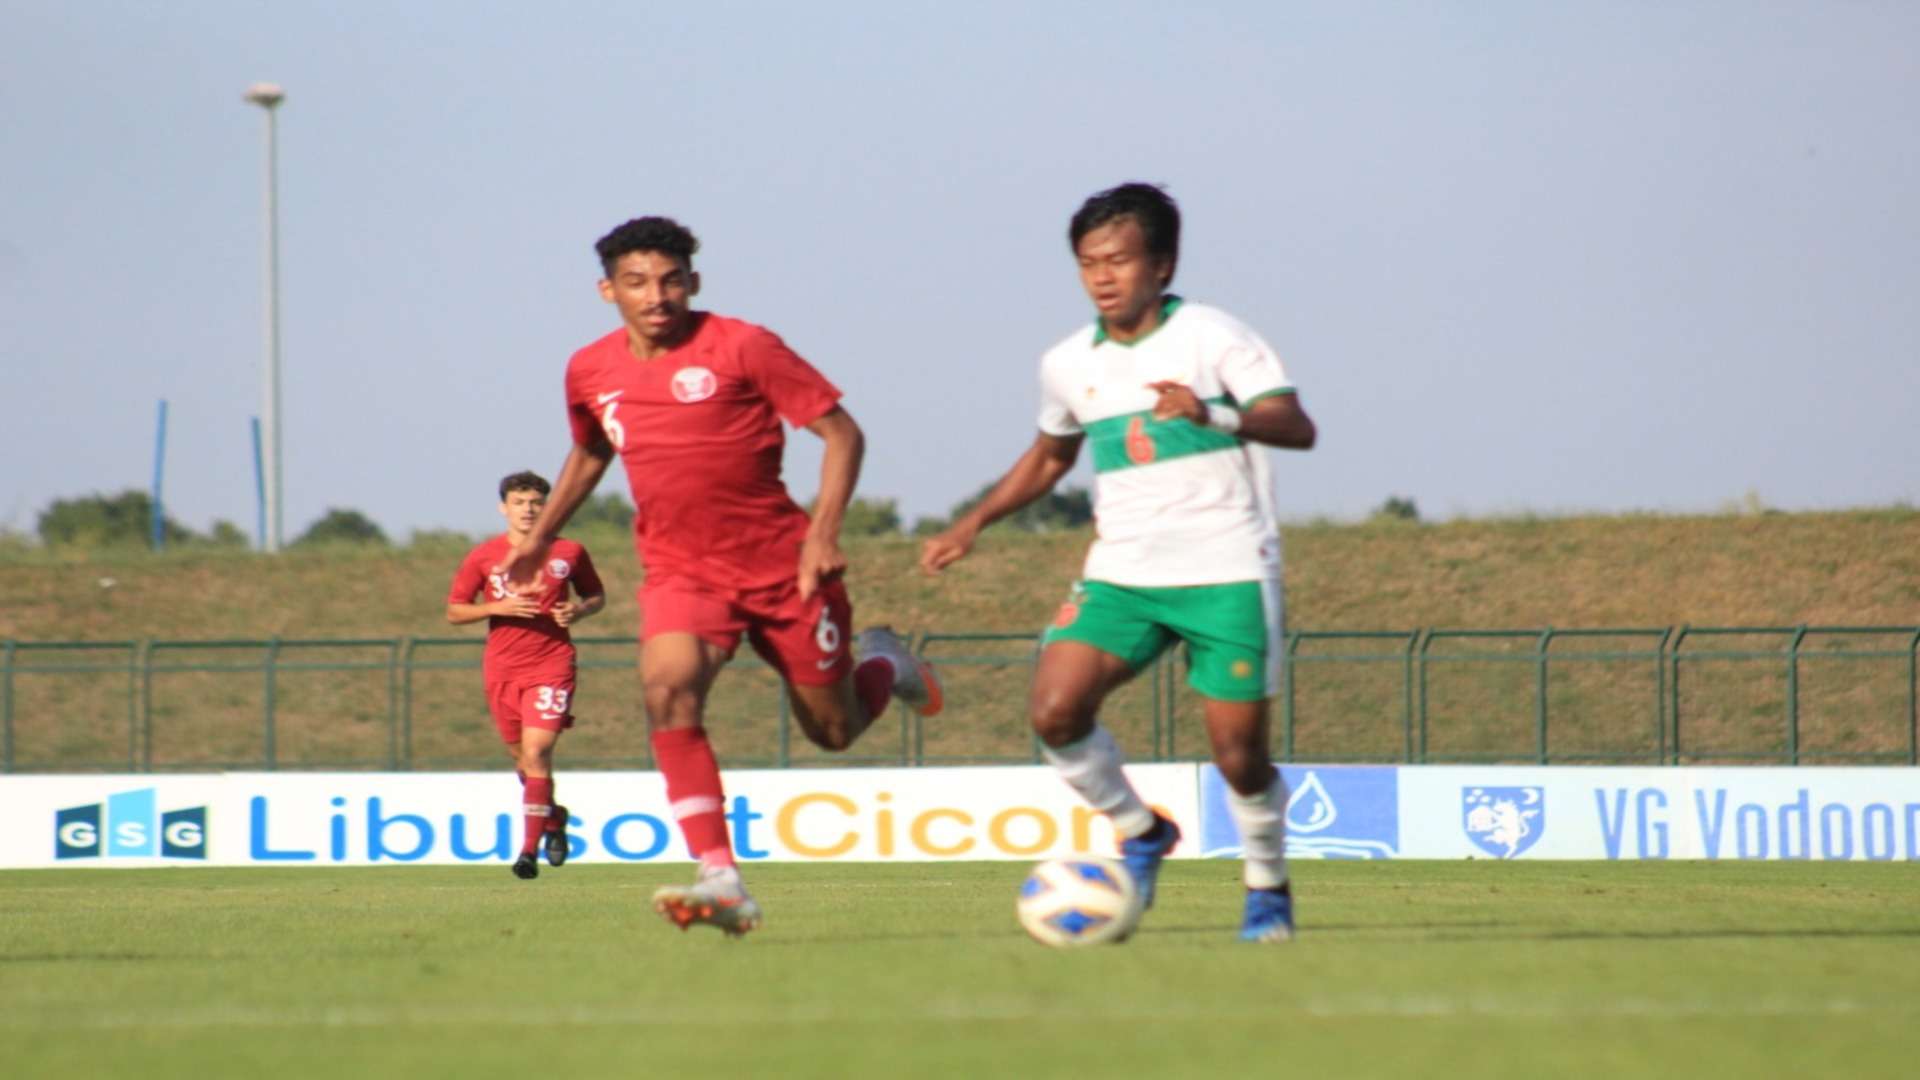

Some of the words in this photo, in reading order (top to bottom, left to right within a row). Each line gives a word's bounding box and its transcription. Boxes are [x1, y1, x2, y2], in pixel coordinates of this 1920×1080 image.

[602, 402, 624, 449] 6
[1125, 416, 1156, 465] 6
[816, 604, 840, 653] 6
[535, 686, 568, 713] 33
[1594, 788, 1669, 860] VG
